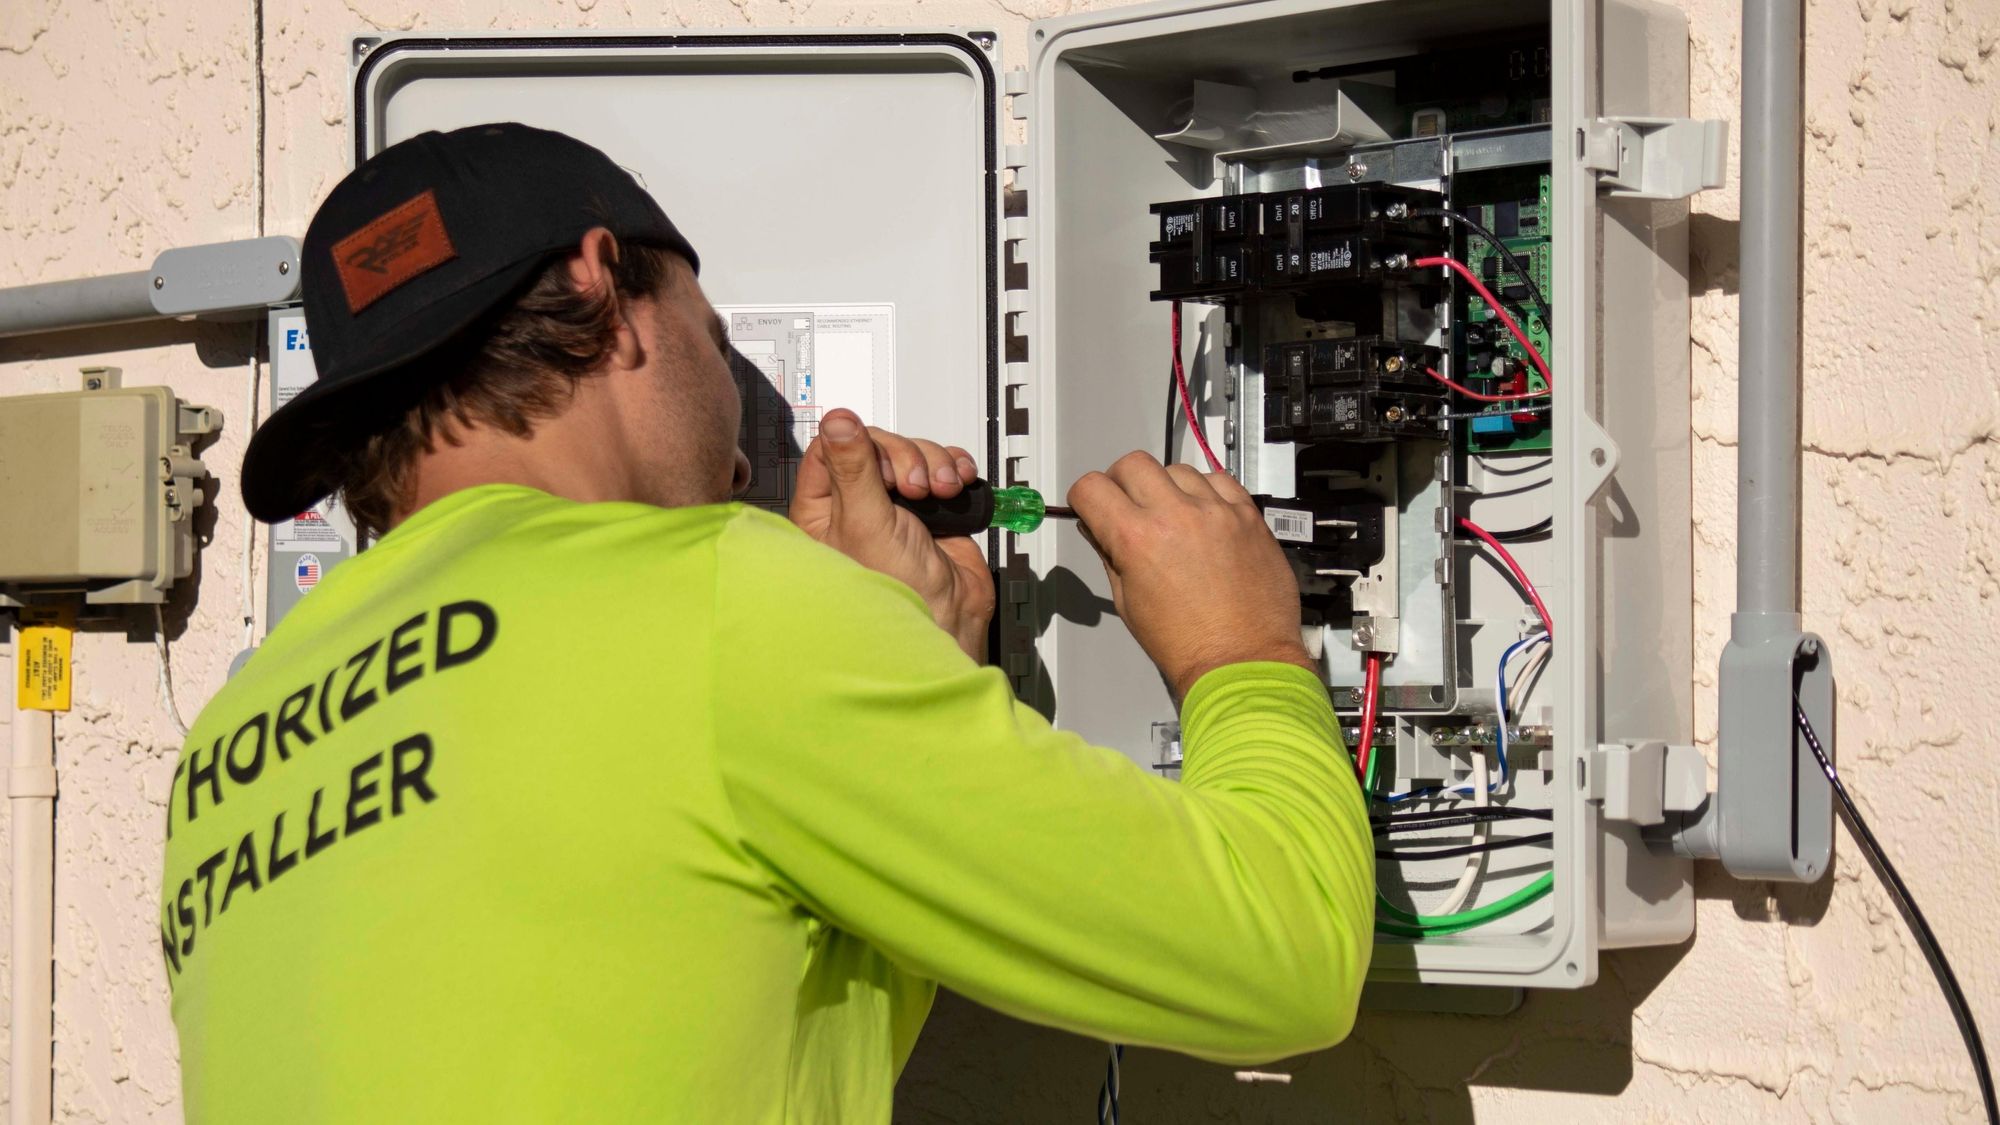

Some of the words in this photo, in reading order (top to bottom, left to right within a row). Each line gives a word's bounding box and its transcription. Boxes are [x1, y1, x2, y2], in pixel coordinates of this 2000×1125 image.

[1292, 204, 1300, 215] 20
[1292, 255, 1300, 266] 20
[1293, 356, 1301, 367] 15
[1294, 406, 1301, 416] 15
